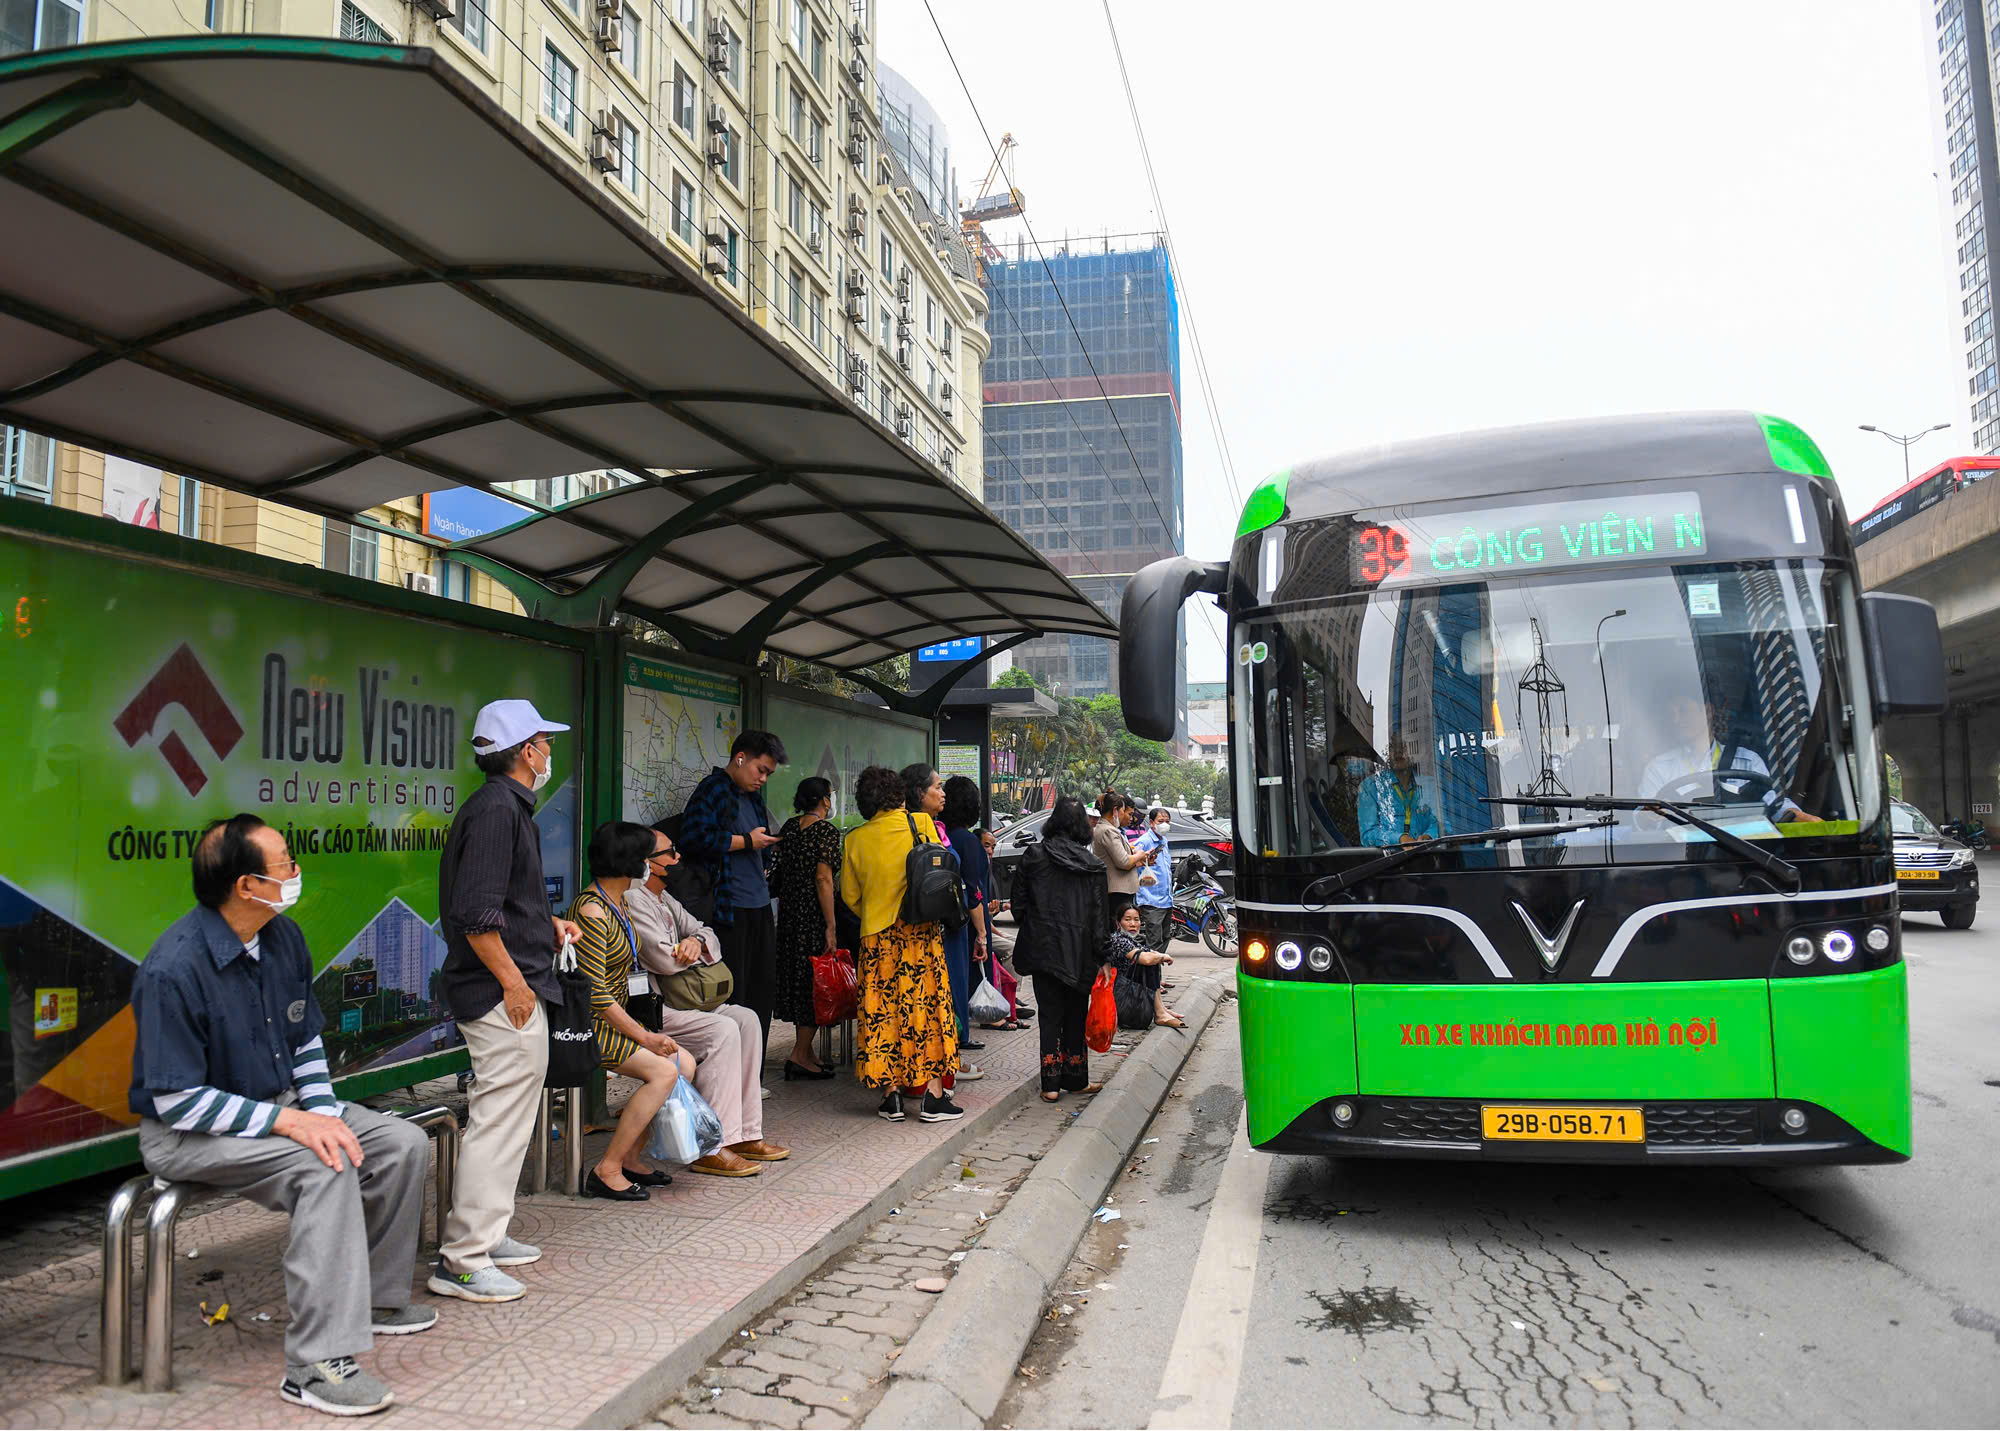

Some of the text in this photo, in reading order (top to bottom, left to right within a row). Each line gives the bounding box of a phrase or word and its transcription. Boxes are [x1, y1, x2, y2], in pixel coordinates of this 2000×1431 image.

[434, 513, 475, 537] Ngân hàng
[1430, 511, 1702, 572] CÔNG VIÊN N
[1359, 525, 1412, 582] 39
[262, 652, 455, 771] New Vision
[258, 770, 455, 815] advertising
[108, 824, 167, 861] CÔNG
[172, 829, 197, 859] TY
[323, 823, 353, 855] CÁO
[357, 821, 388, 853] TẦM
[391, 823, 426, 852] NHÌN
[429, 823, 451, 852] MỚ
[1434, 1023, 1464, 1046] XE
[1469, 1017, 1551, 1047] KHÁCH
[1625, 1016, 1660, 1047] HÀ
[1668, 1016, 1718, 1053] NỘI
[1496, 1113, 1627, 1135] 29B-058.71
